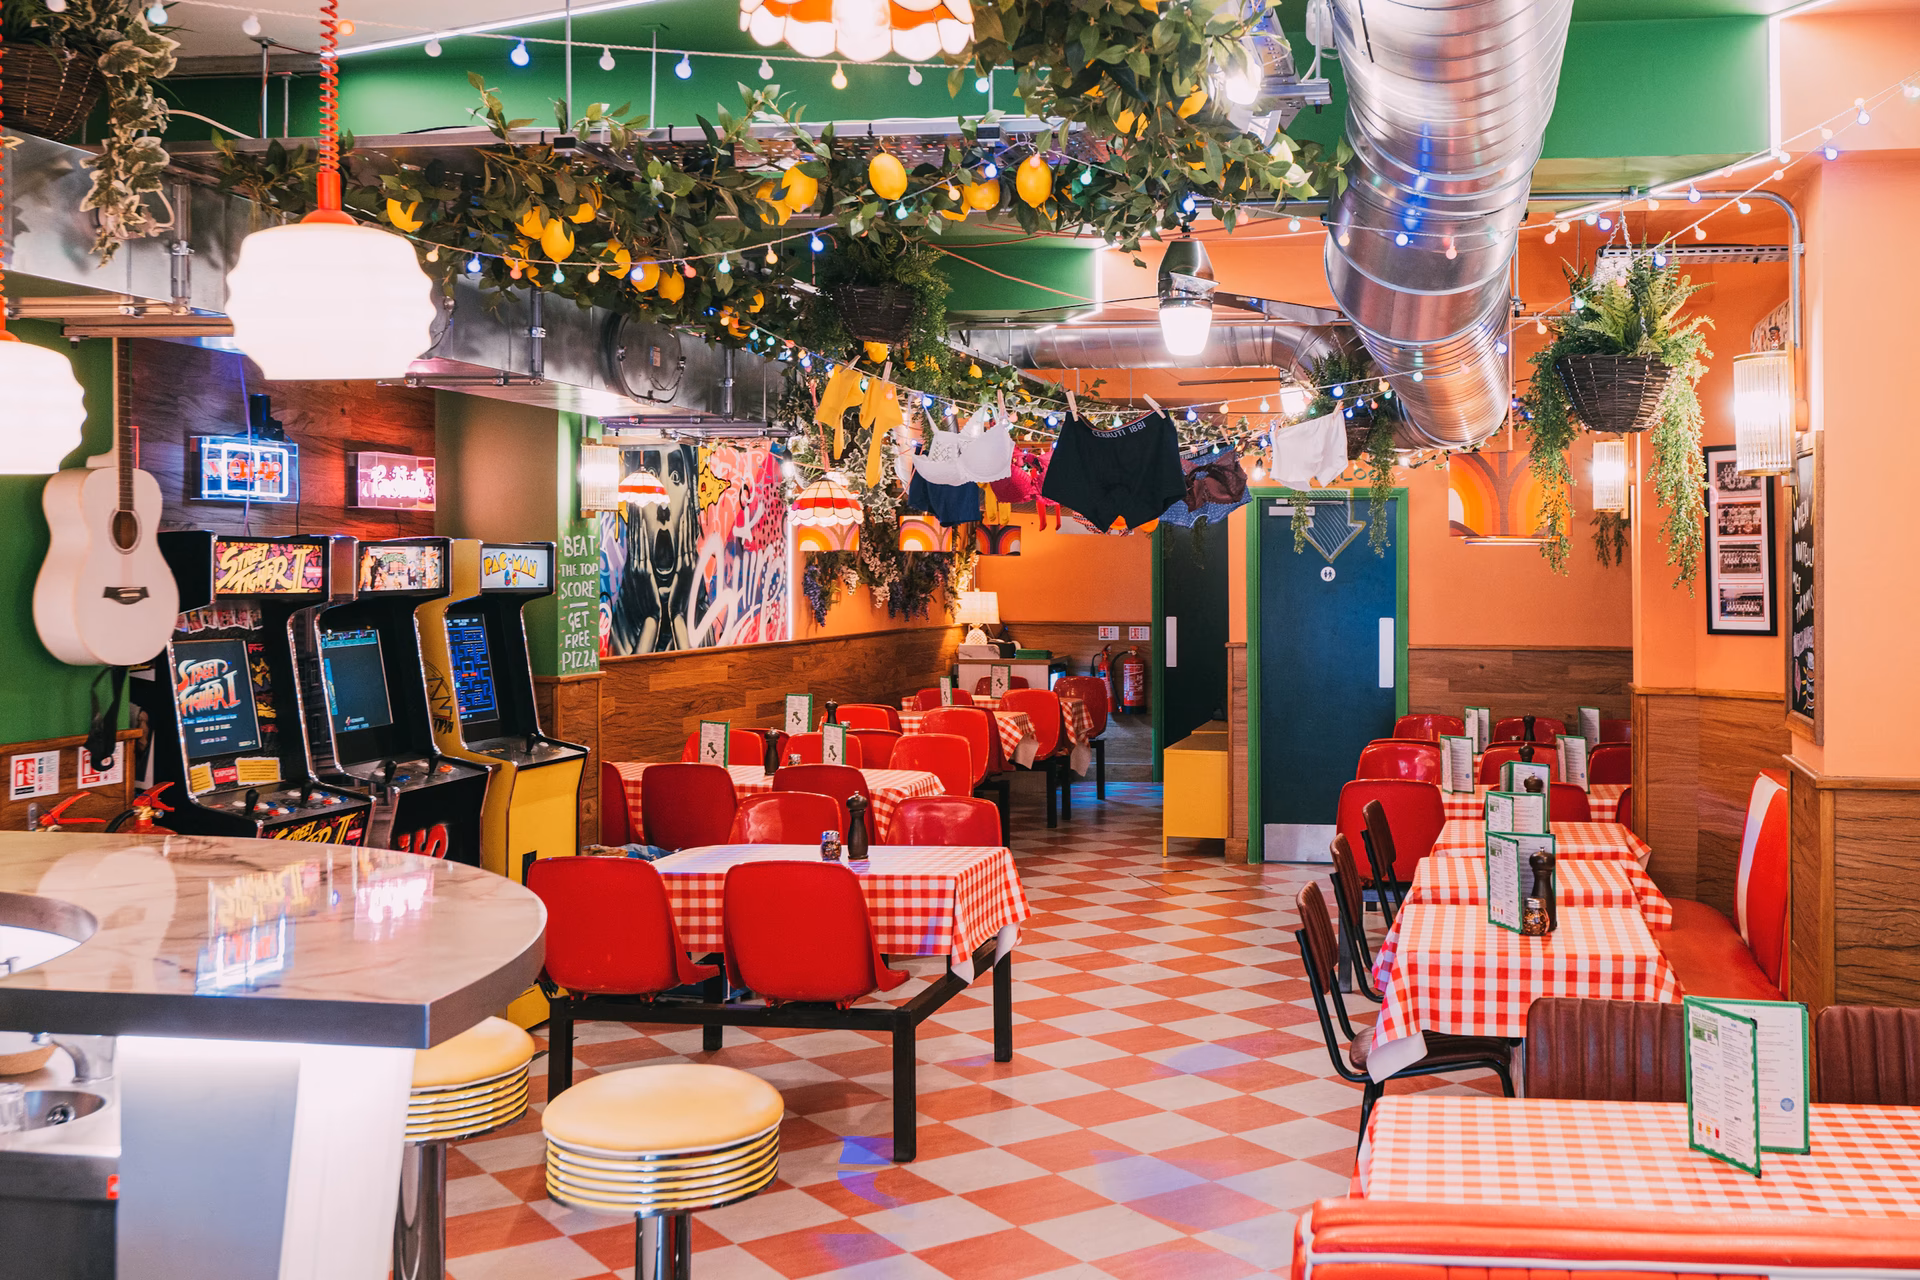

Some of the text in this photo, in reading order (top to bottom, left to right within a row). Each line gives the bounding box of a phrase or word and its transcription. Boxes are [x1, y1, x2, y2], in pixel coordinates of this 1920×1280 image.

[1092, 420, 1146, 438] CERRUTI 1881
[563, 535, 596, 557] BEAT
[216, 544, 269, 591] STREET
[226, 548, 313, 593] FIGHTER II
[483, 551, 538, 579] PAC-MAN
[560, 562, 599, 577] THE TOP
[560, 580, 596, 600] SCORE
[568, 610, 590, 633] GET
[565, 629, 591, 649] FREE
[562, 648, 598, 672] PIZZA
[178, 658, 228, 692] STREET
